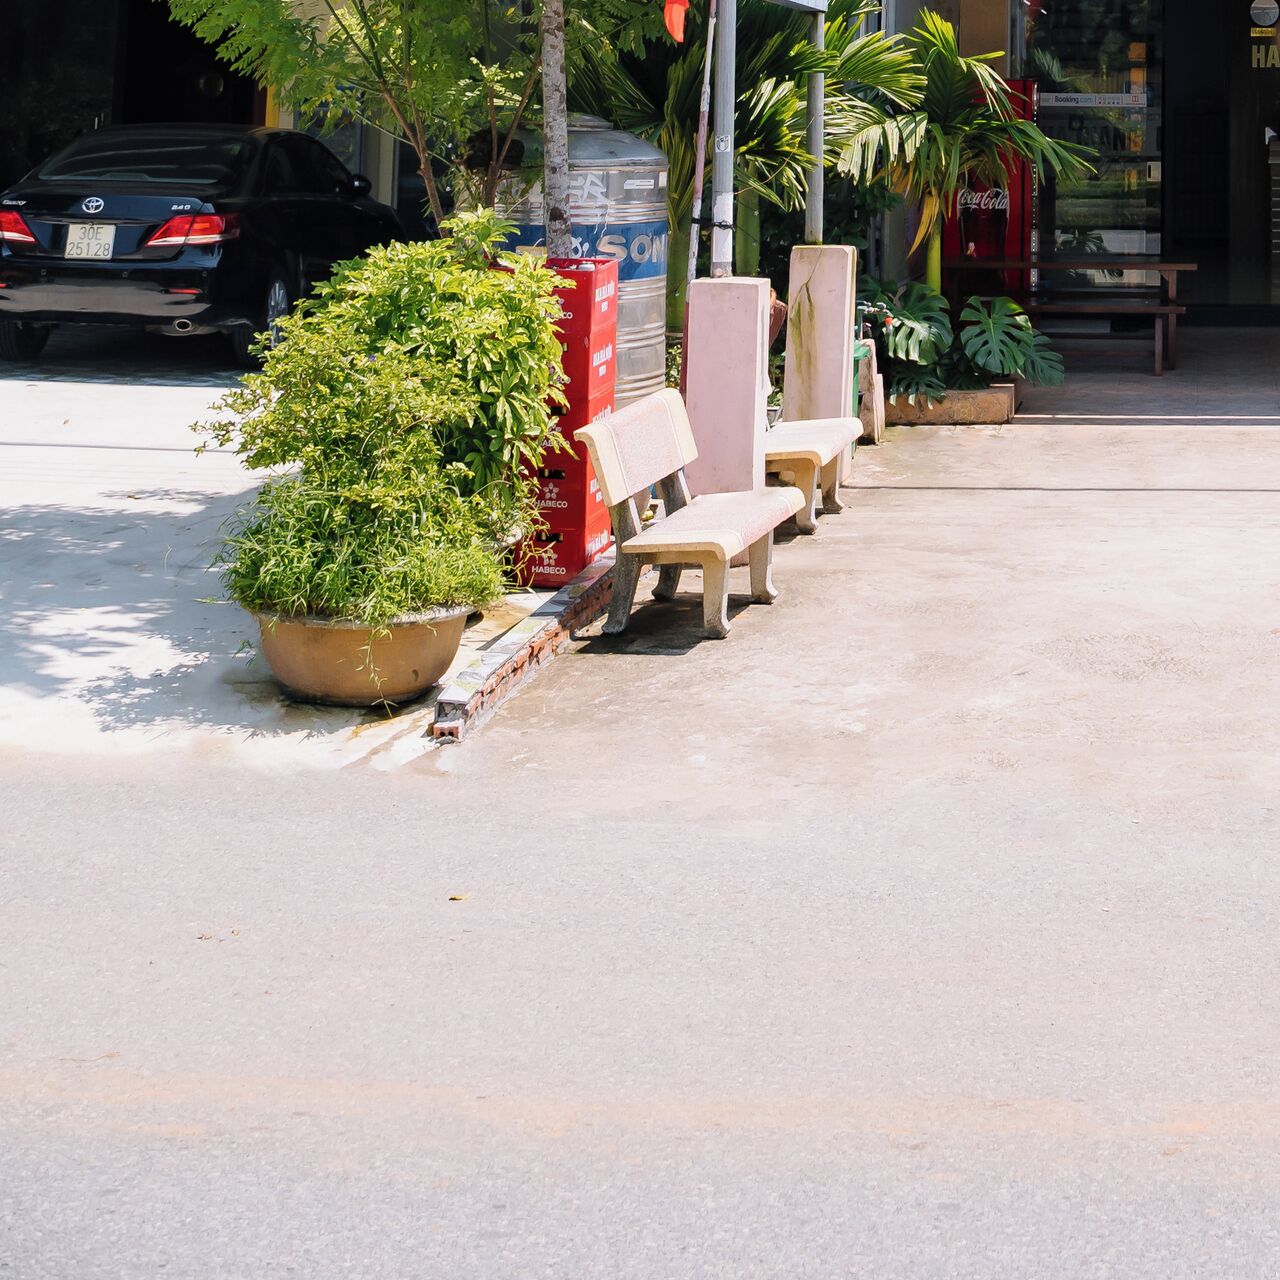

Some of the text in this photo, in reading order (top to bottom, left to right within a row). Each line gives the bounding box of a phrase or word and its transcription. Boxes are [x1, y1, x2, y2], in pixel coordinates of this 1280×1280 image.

[1251, 45, 1280, 68] HA
[79, 226, 103, 241] 30E
[67, 241, 110, 257] 251.28
[531, 564, 567, 576] HABECO
